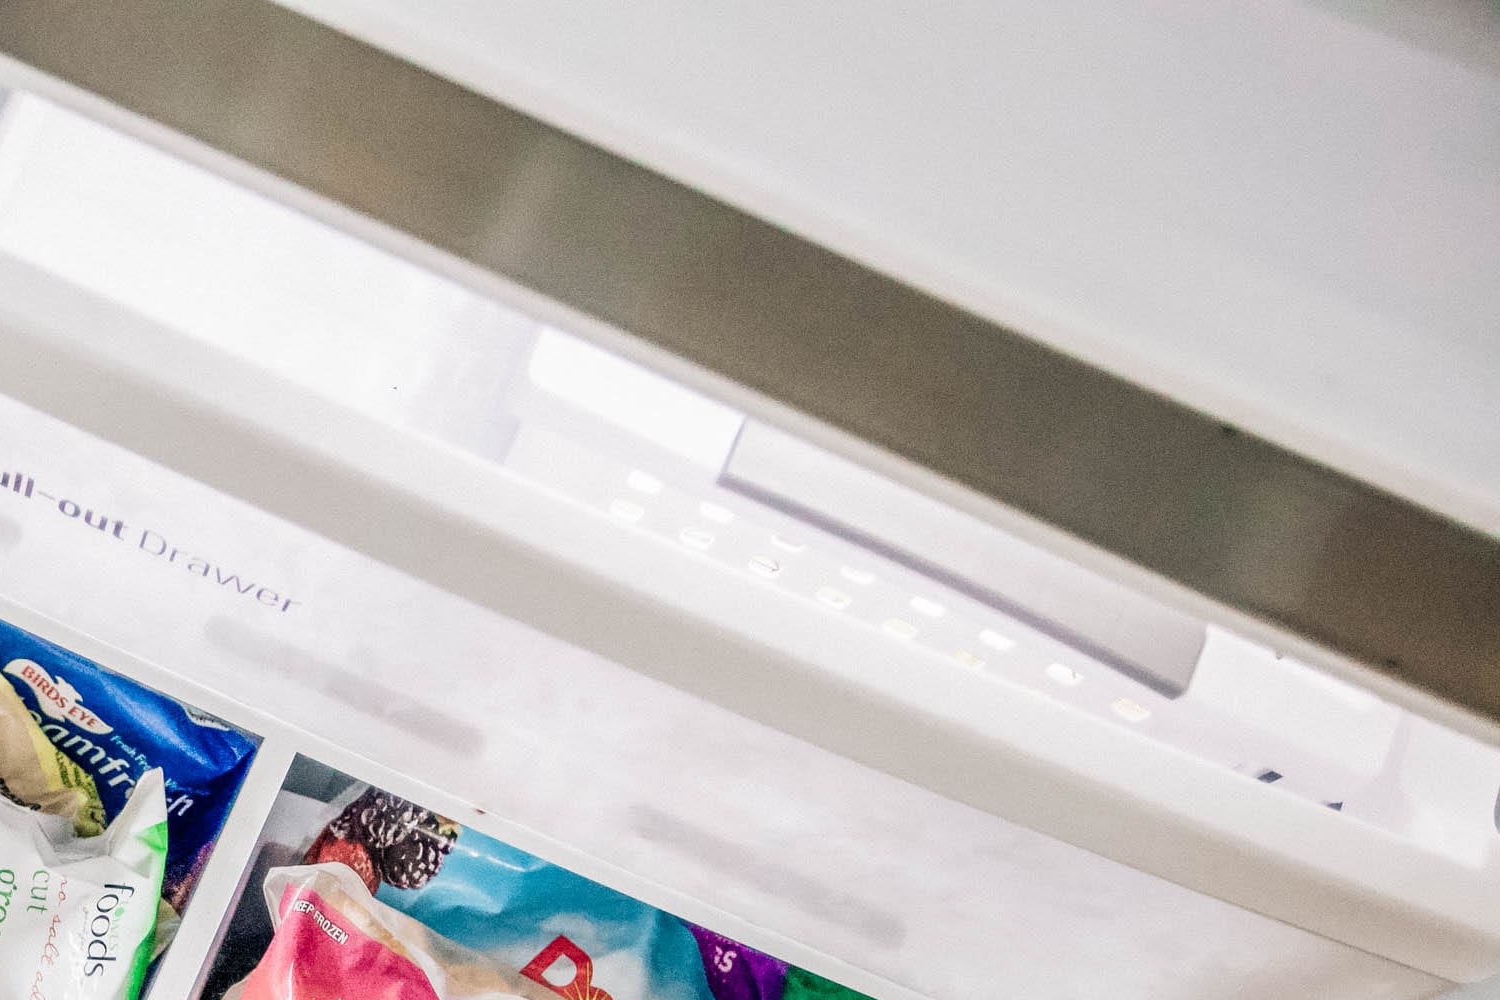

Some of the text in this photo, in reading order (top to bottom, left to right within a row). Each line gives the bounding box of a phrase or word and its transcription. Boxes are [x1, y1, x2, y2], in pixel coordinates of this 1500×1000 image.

[138, 529, 303, 613] Drawer
[20, 664, 99, 728] BIRDS EYE
[26, 869, 51, 916] cut
[84, 883, 136, 978] foods
[313, 911, 349, 945] FROZEN
